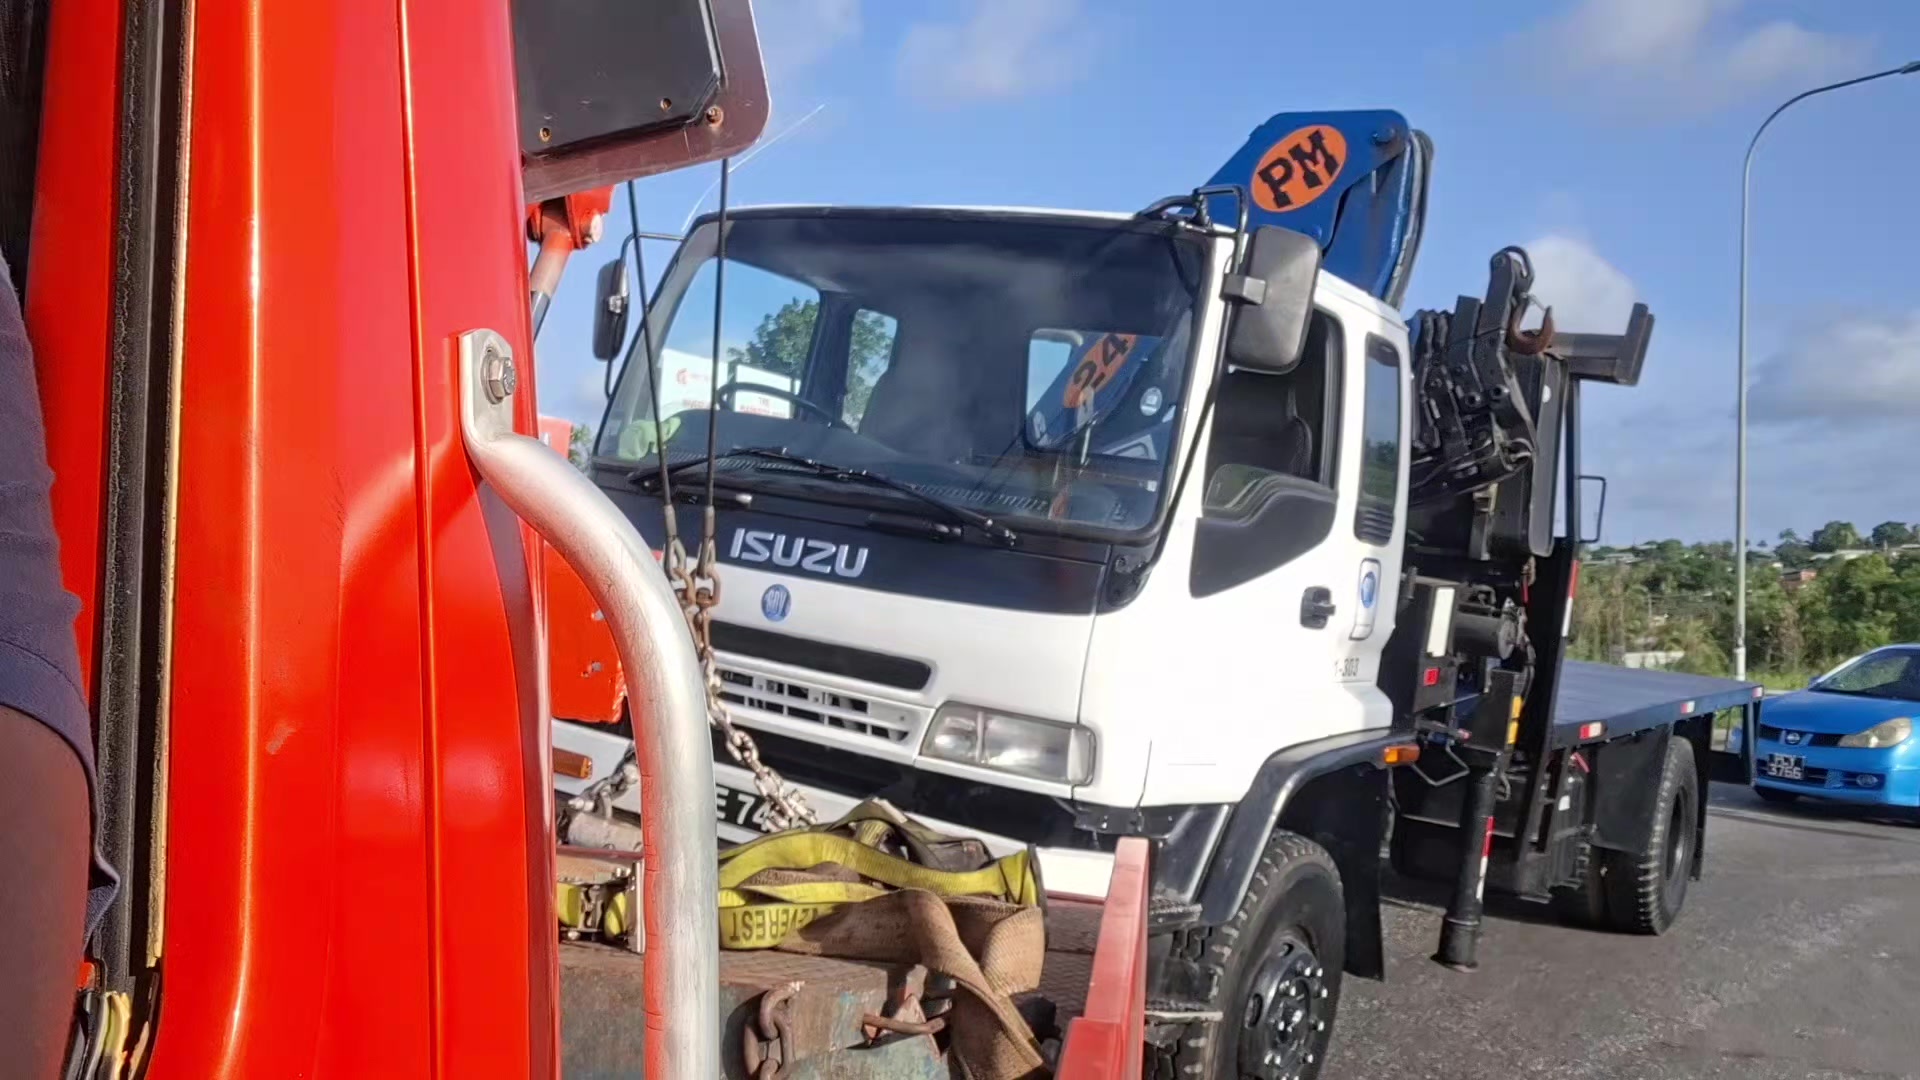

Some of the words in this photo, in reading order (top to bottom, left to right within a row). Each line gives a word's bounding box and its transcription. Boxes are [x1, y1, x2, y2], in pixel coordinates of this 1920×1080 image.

[1257, 129, 1340, 209] PM
[1073, 333, 1130, 390] 24
[729, 527, 870, 579] ISUZU
